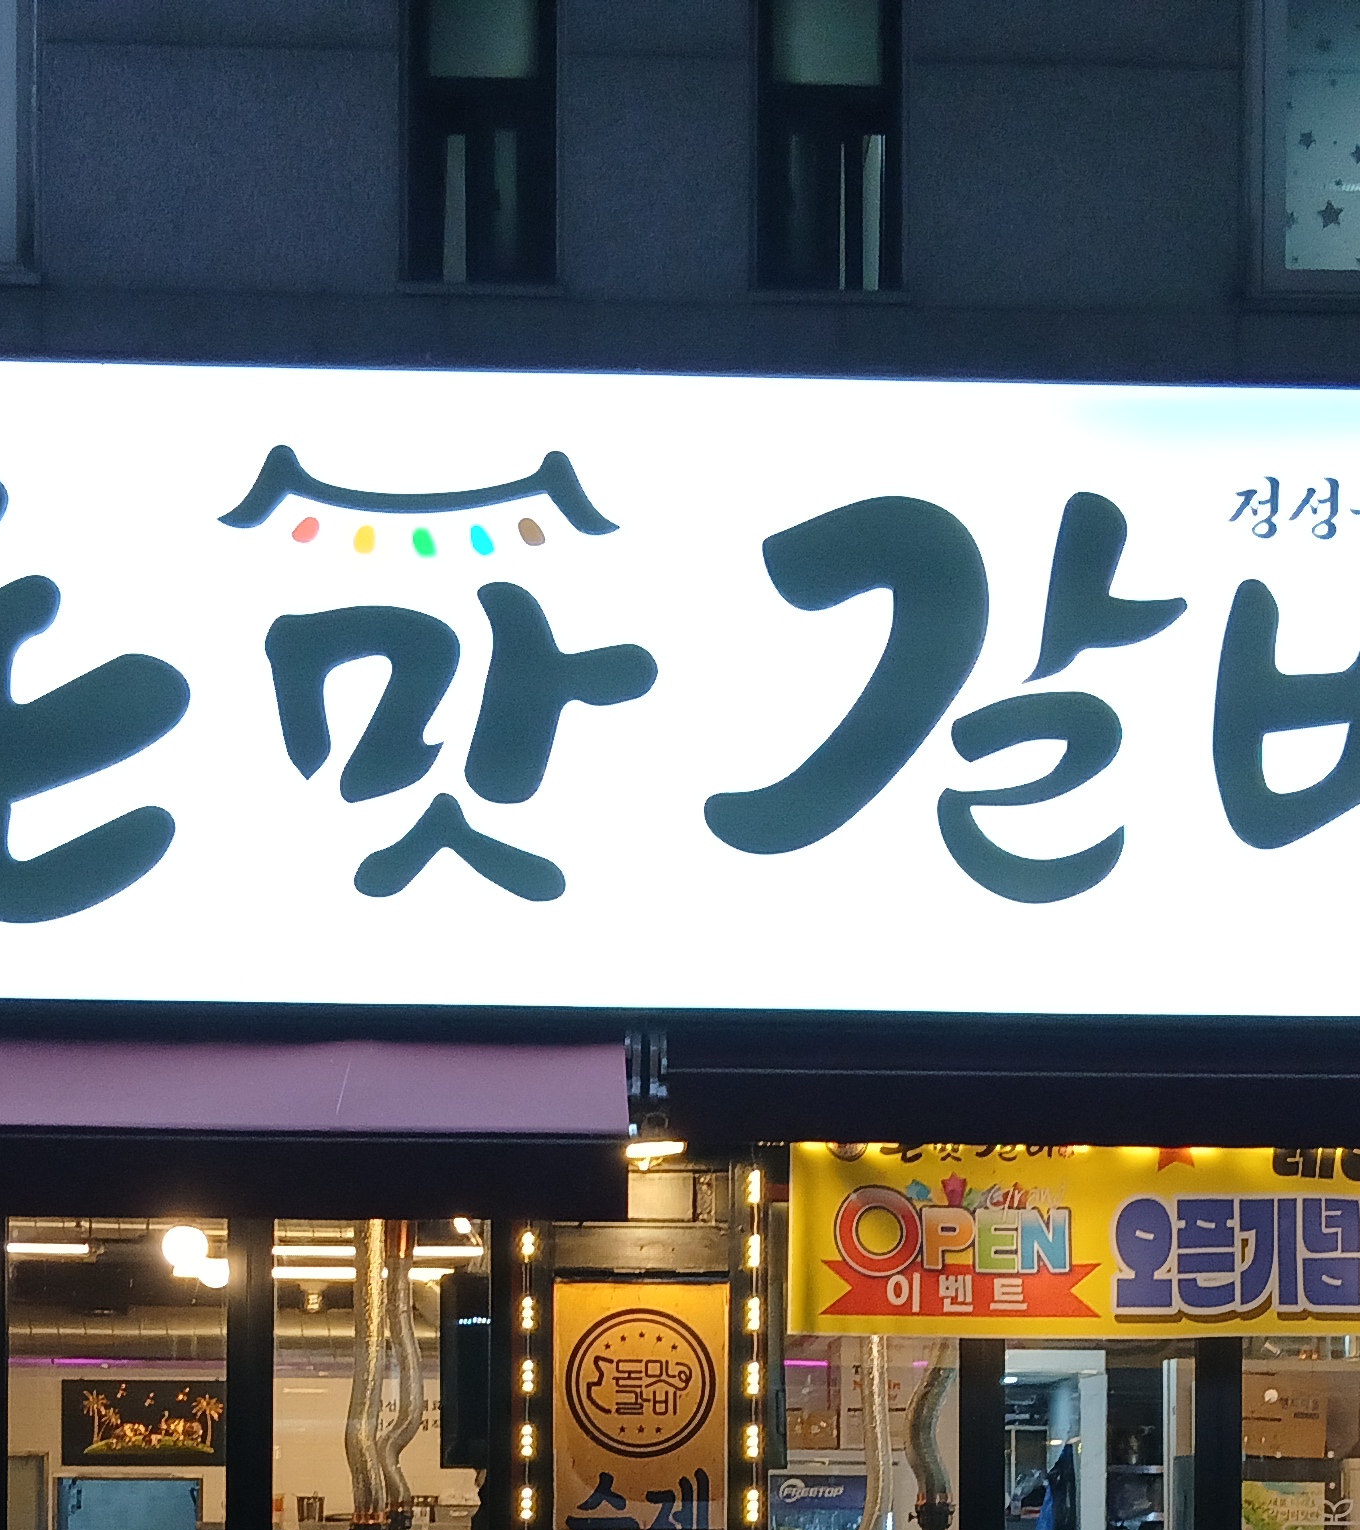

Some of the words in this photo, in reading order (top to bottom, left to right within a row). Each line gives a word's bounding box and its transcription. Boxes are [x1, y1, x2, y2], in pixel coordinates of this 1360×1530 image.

[835, 1185, 1072, 1276] OPEN
[887, 1274, 1028, 1313] 이벤트
[612, 1358, 682, 1389] 돈맛
[615, 1389, 679, 1416] 갈비
